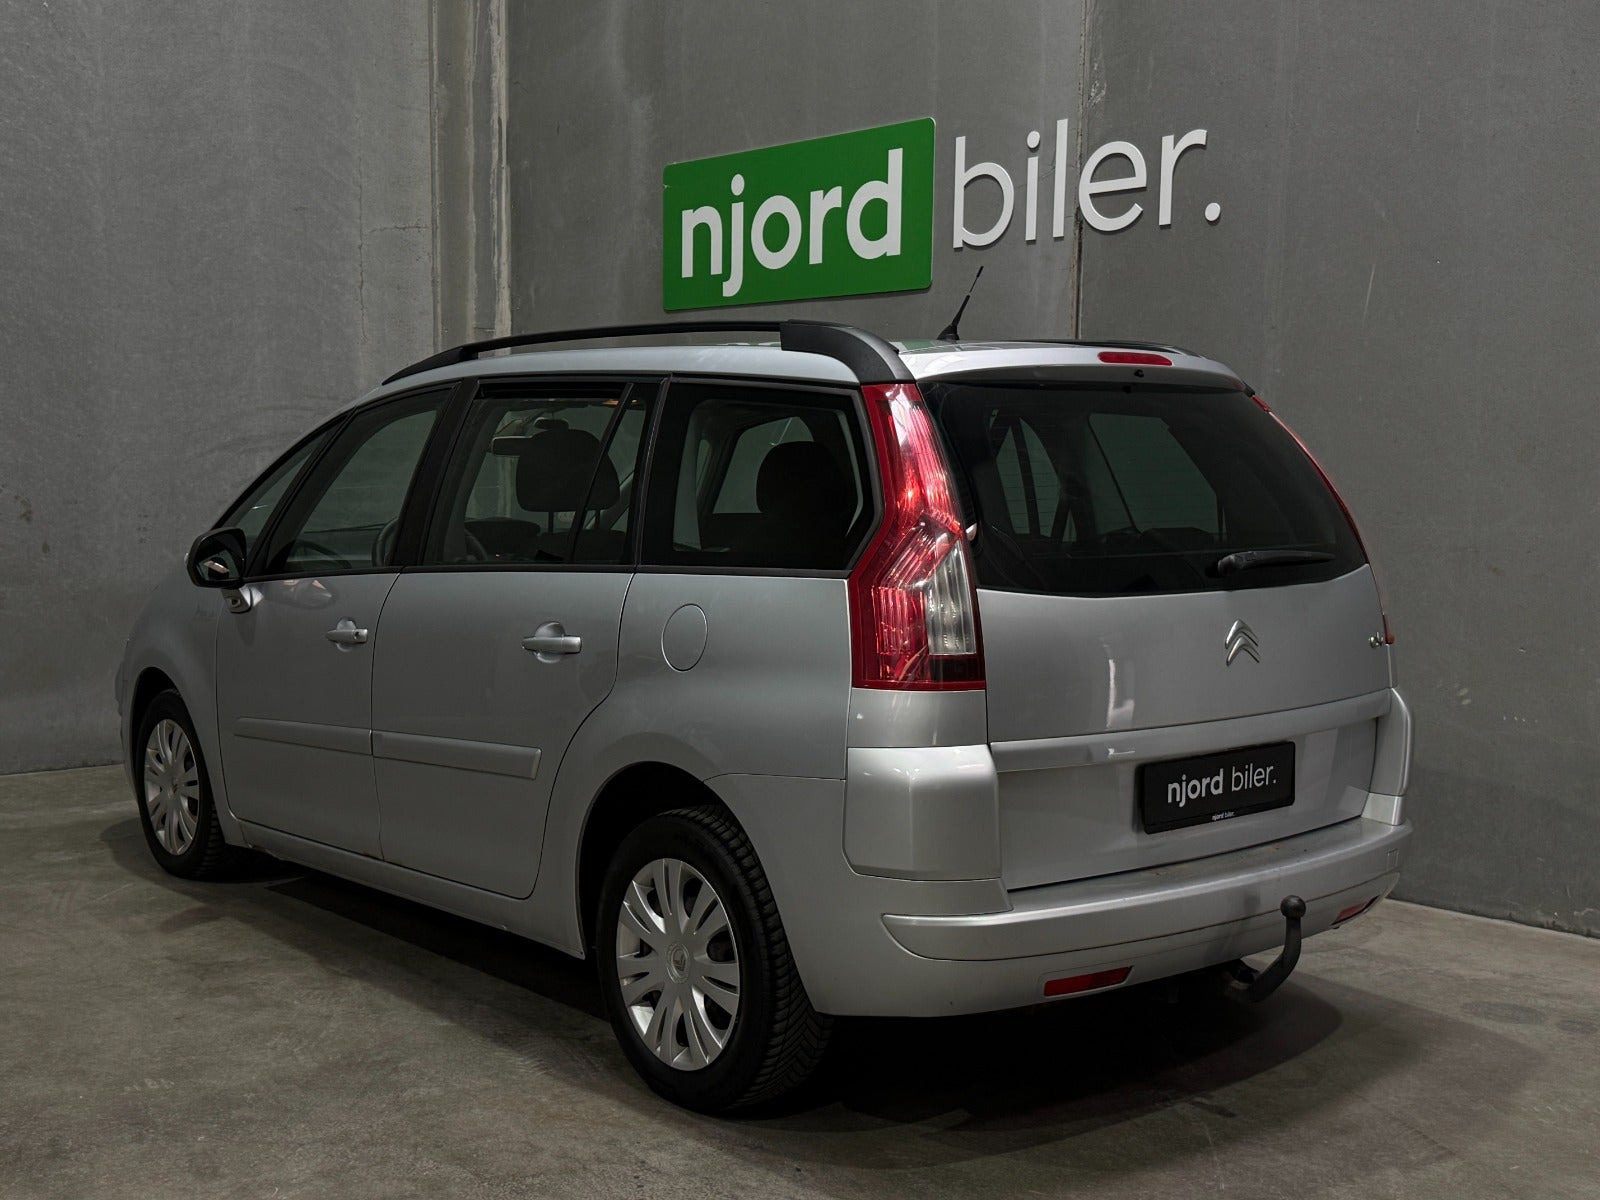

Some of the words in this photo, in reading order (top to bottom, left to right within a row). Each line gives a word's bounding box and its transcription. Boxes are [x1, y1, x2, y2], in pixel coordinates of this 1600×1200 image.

[680, 148, 904, 297] njord
[953, 118, 1221, 249] biler.
[1167, 768, 1224, 808] njord
[1231, 763, 1277, 792] biler.
